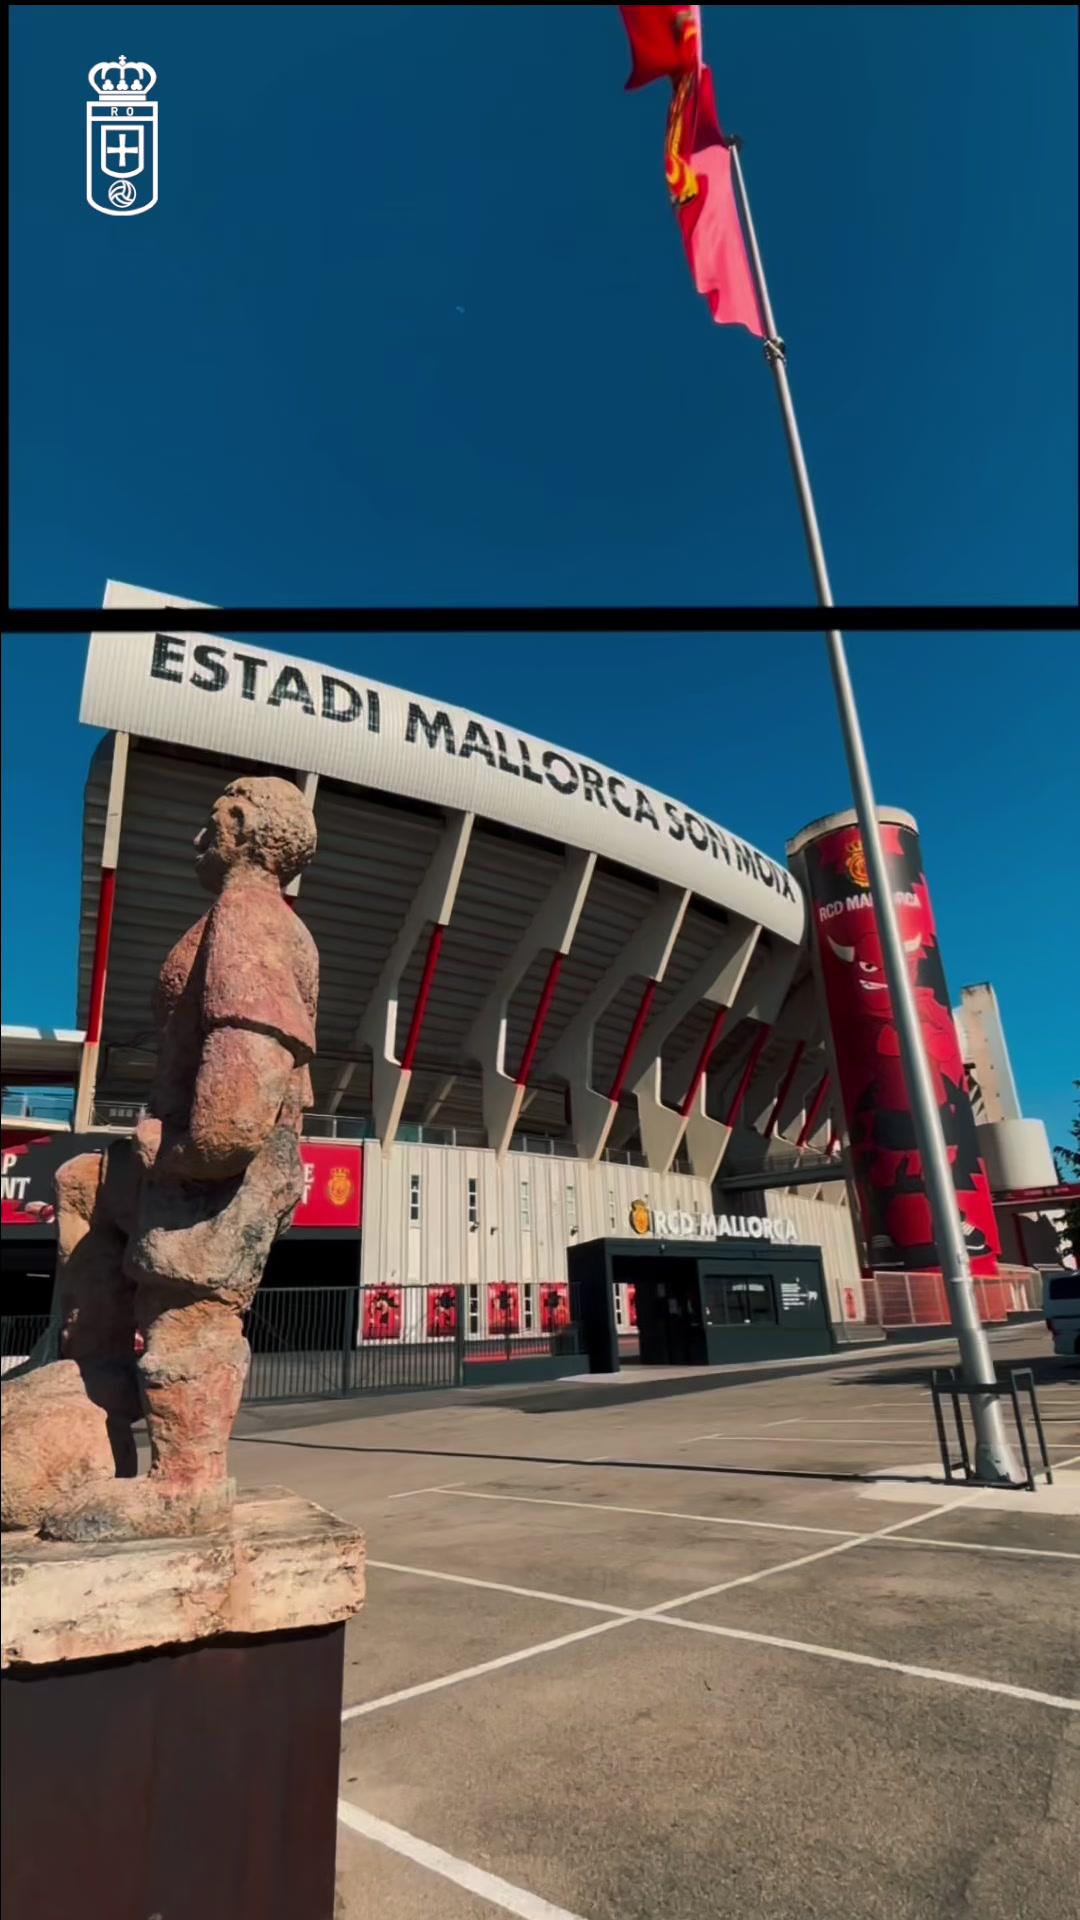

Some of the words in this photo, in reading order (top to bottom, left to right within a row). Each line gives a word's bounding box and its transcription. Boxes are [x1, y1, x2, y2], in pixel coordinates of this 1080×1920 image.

[150, 632, 381, 734] ESTADI
[405, 701, 660, 831] MALLORCA
[664, 801, 731, 867] SON
[730, 836, 797, 904] MOIX
[818, 899, 844, 923] RCD
[653, 1209, 694, 1236] RCD
[700, 1212, 798, 1241] MALLORCA
